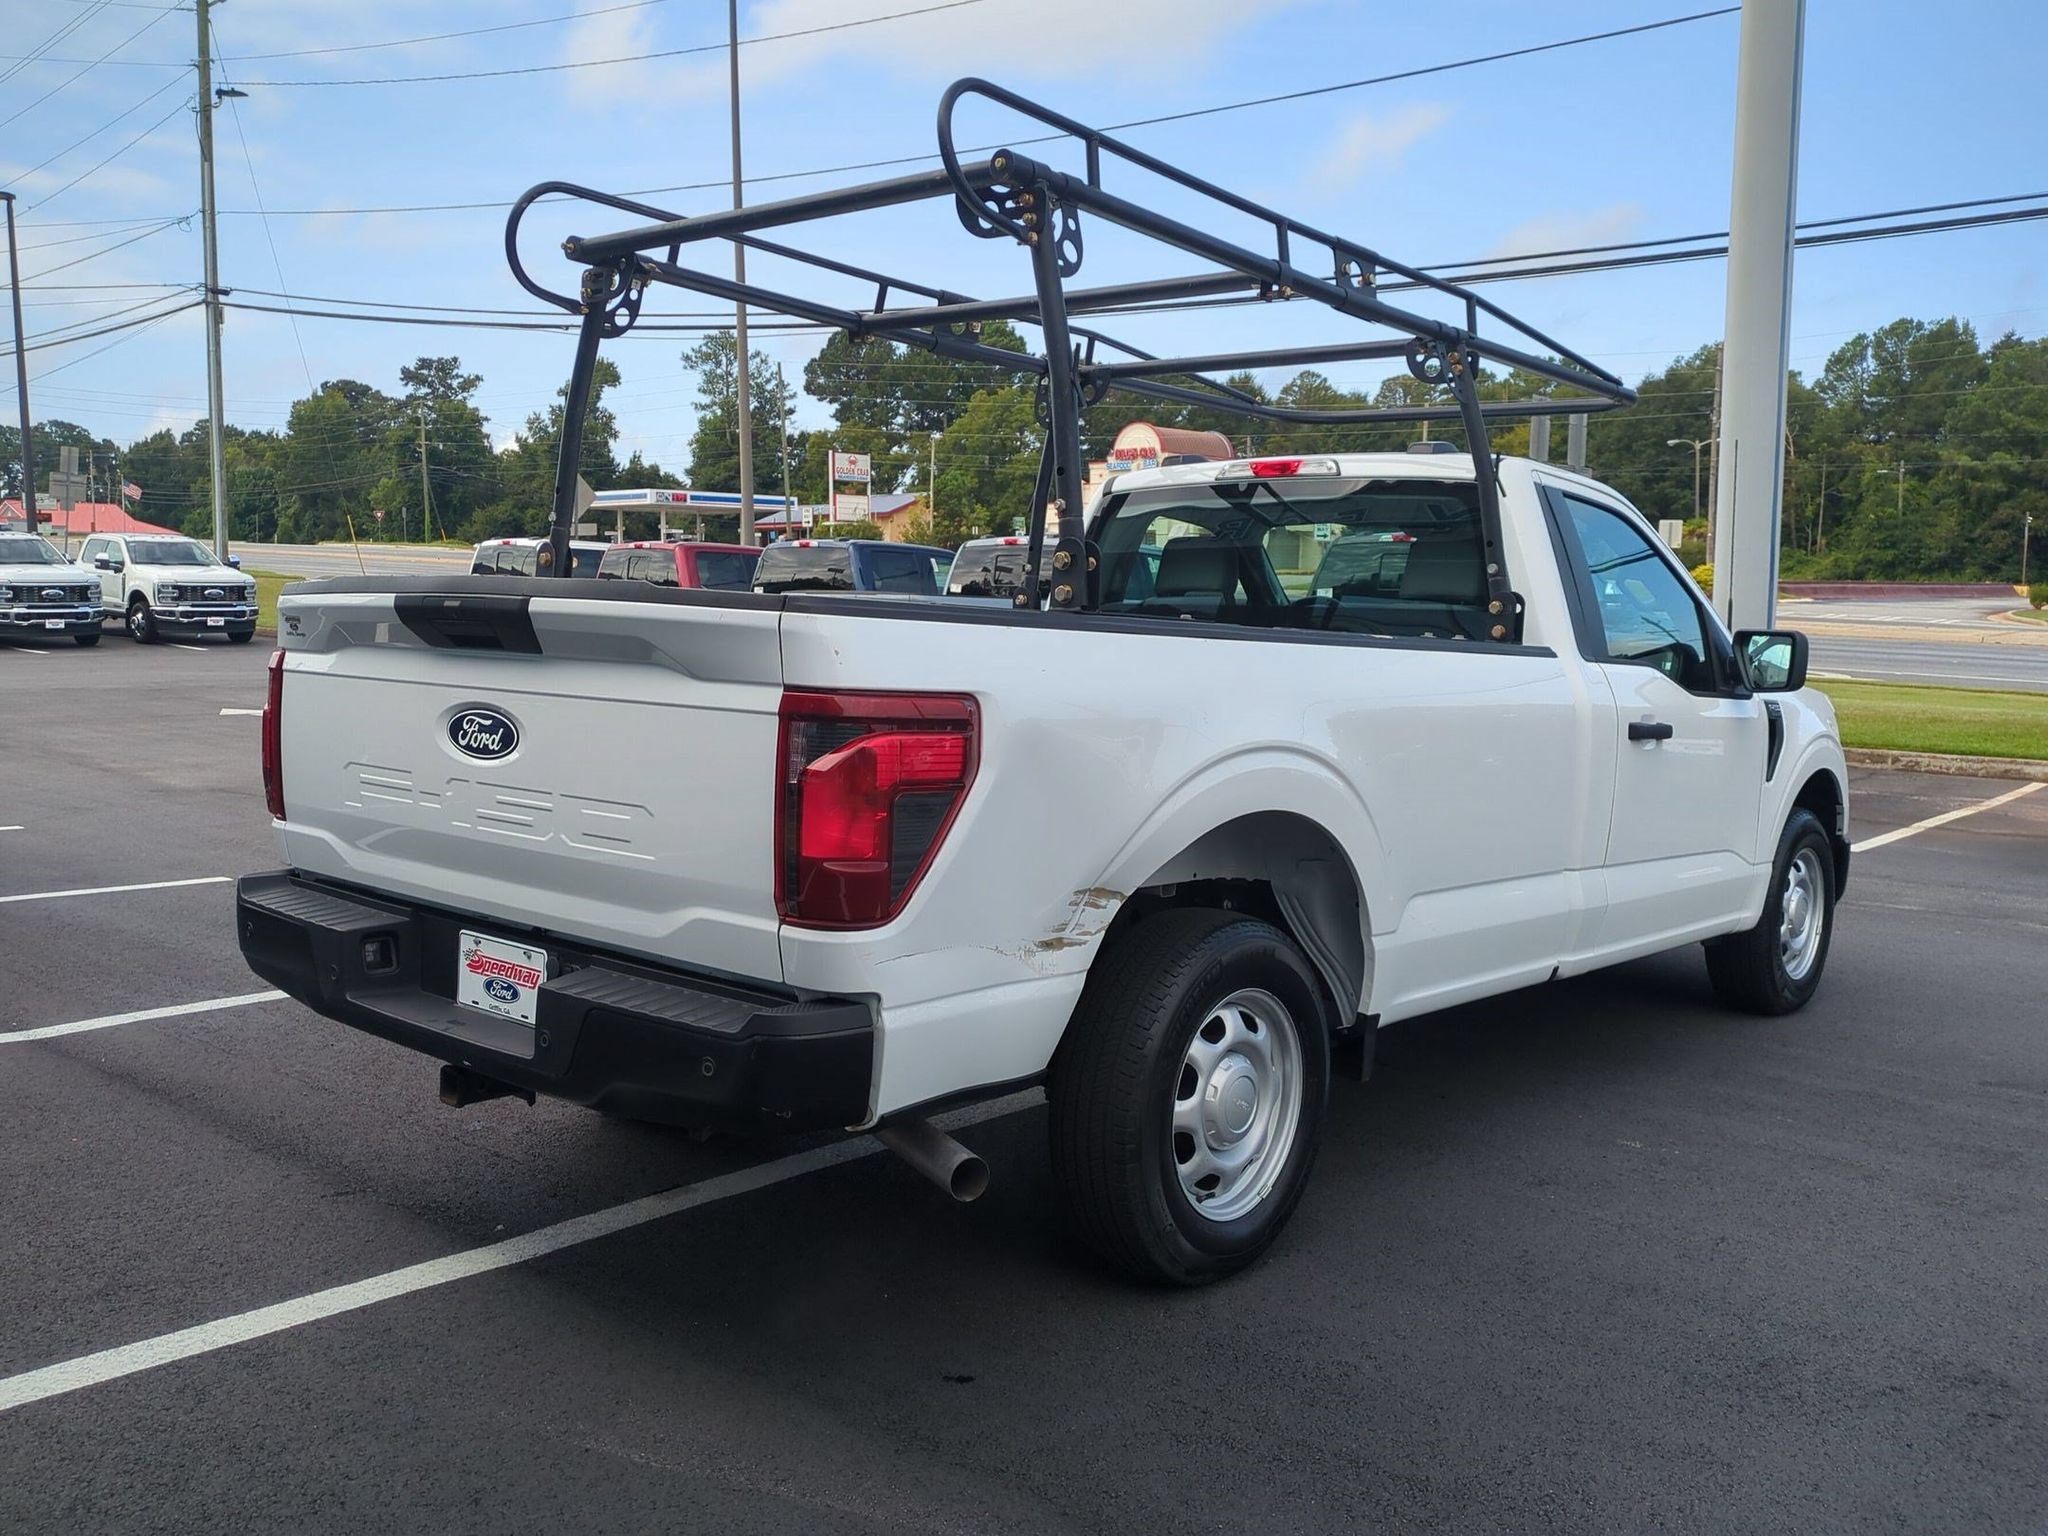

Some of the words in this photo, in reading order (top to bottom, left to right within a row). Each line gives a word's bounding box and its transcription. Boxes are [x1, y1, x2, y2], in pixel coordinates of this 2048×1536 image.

[836, 466, 856, 475] GOLDEN
[857, 468, 869, 476] CRAB
[1106, 462, 1131, 470] SEAFOOD
[459, 715, 504, 750] Ford
[466, 949, 541, 990] Speedway
[490, 980, 513, 1000] Ford
